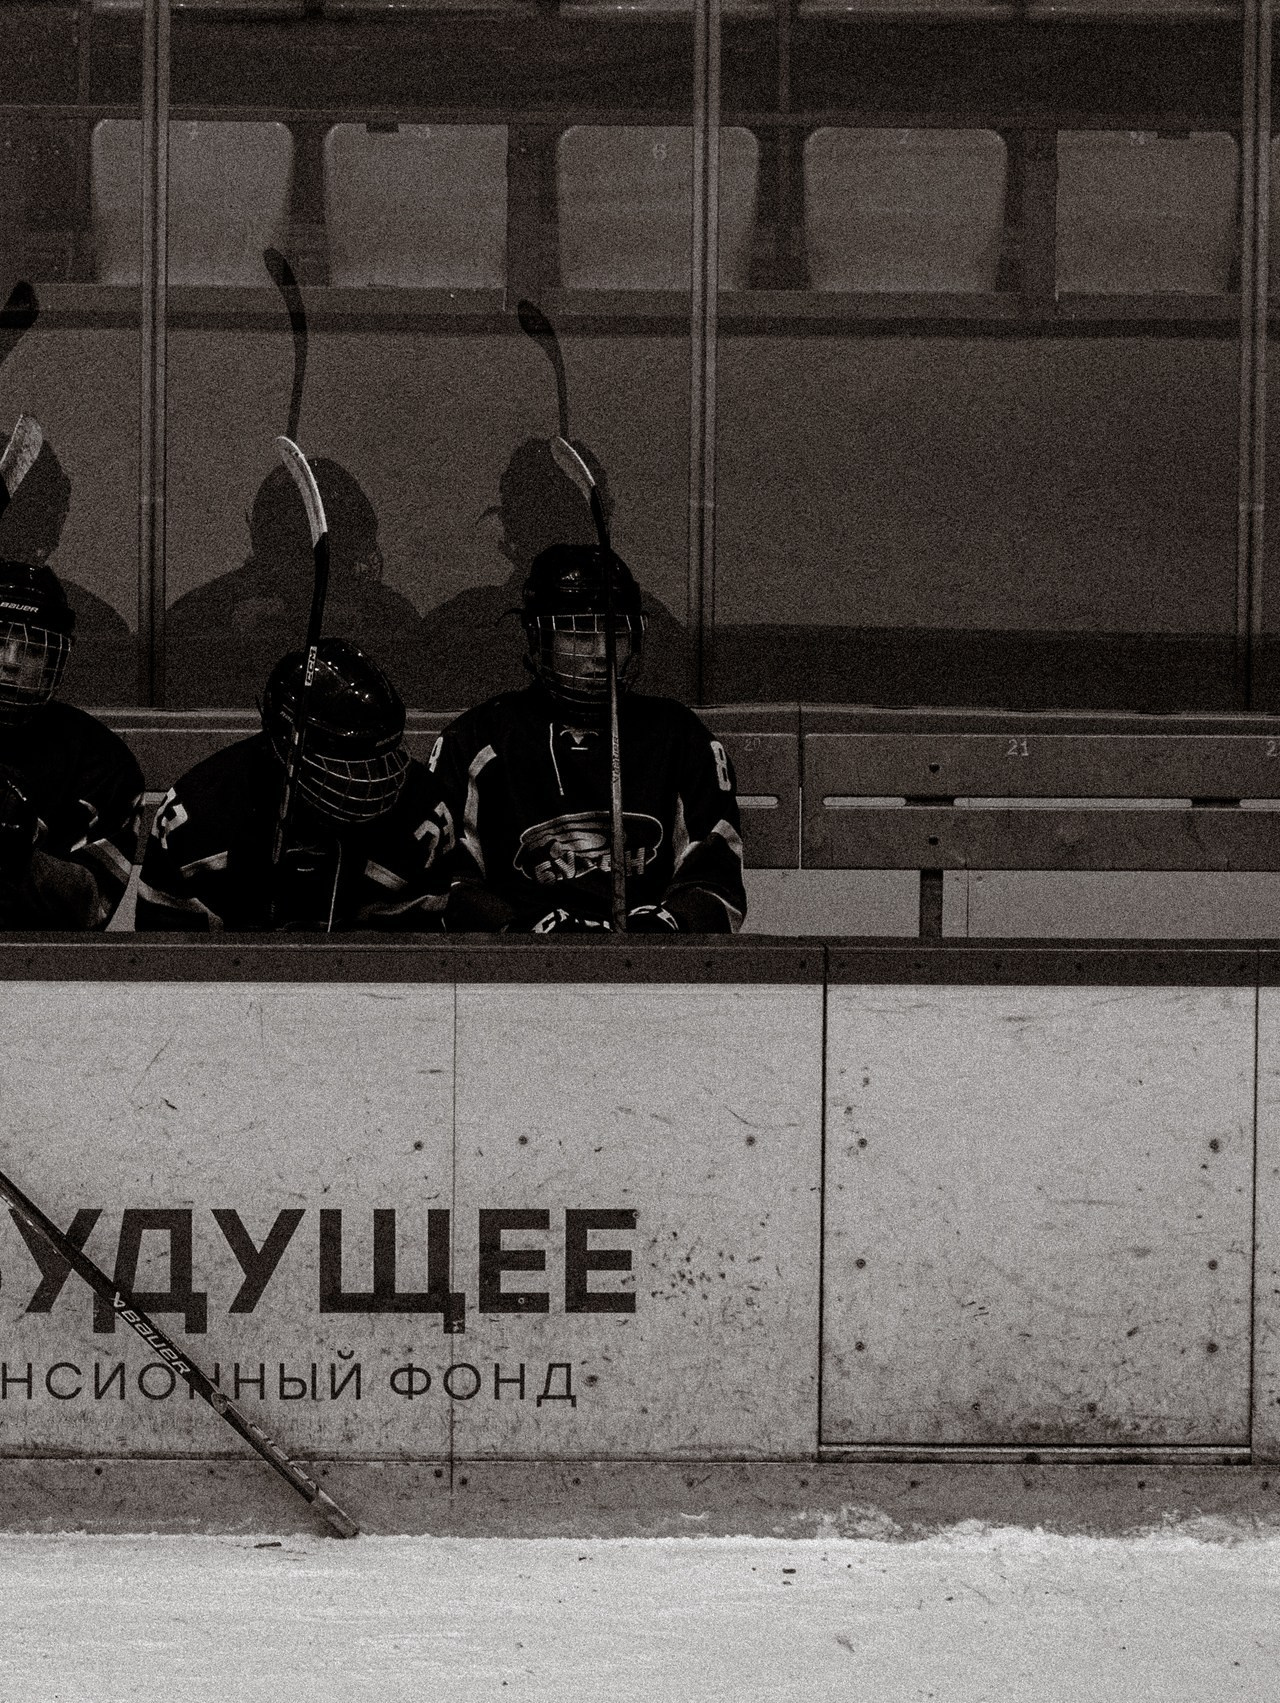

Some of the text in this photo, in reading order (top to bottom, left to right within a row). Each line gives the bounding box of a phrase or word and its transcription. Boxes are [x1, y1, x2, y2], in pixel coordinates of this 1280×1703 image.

[0, 601, 40, 614] BAUER
[306, 649, 317, 683] CCM
[1007, 738, 1030, 757] 21
[1266, 740, 1280, 757] 2
[710, 740, 732, 791] 8
[121, 1309, 191, 1374] BAUER
[389, 1362, 577, 1407] ФОНД
